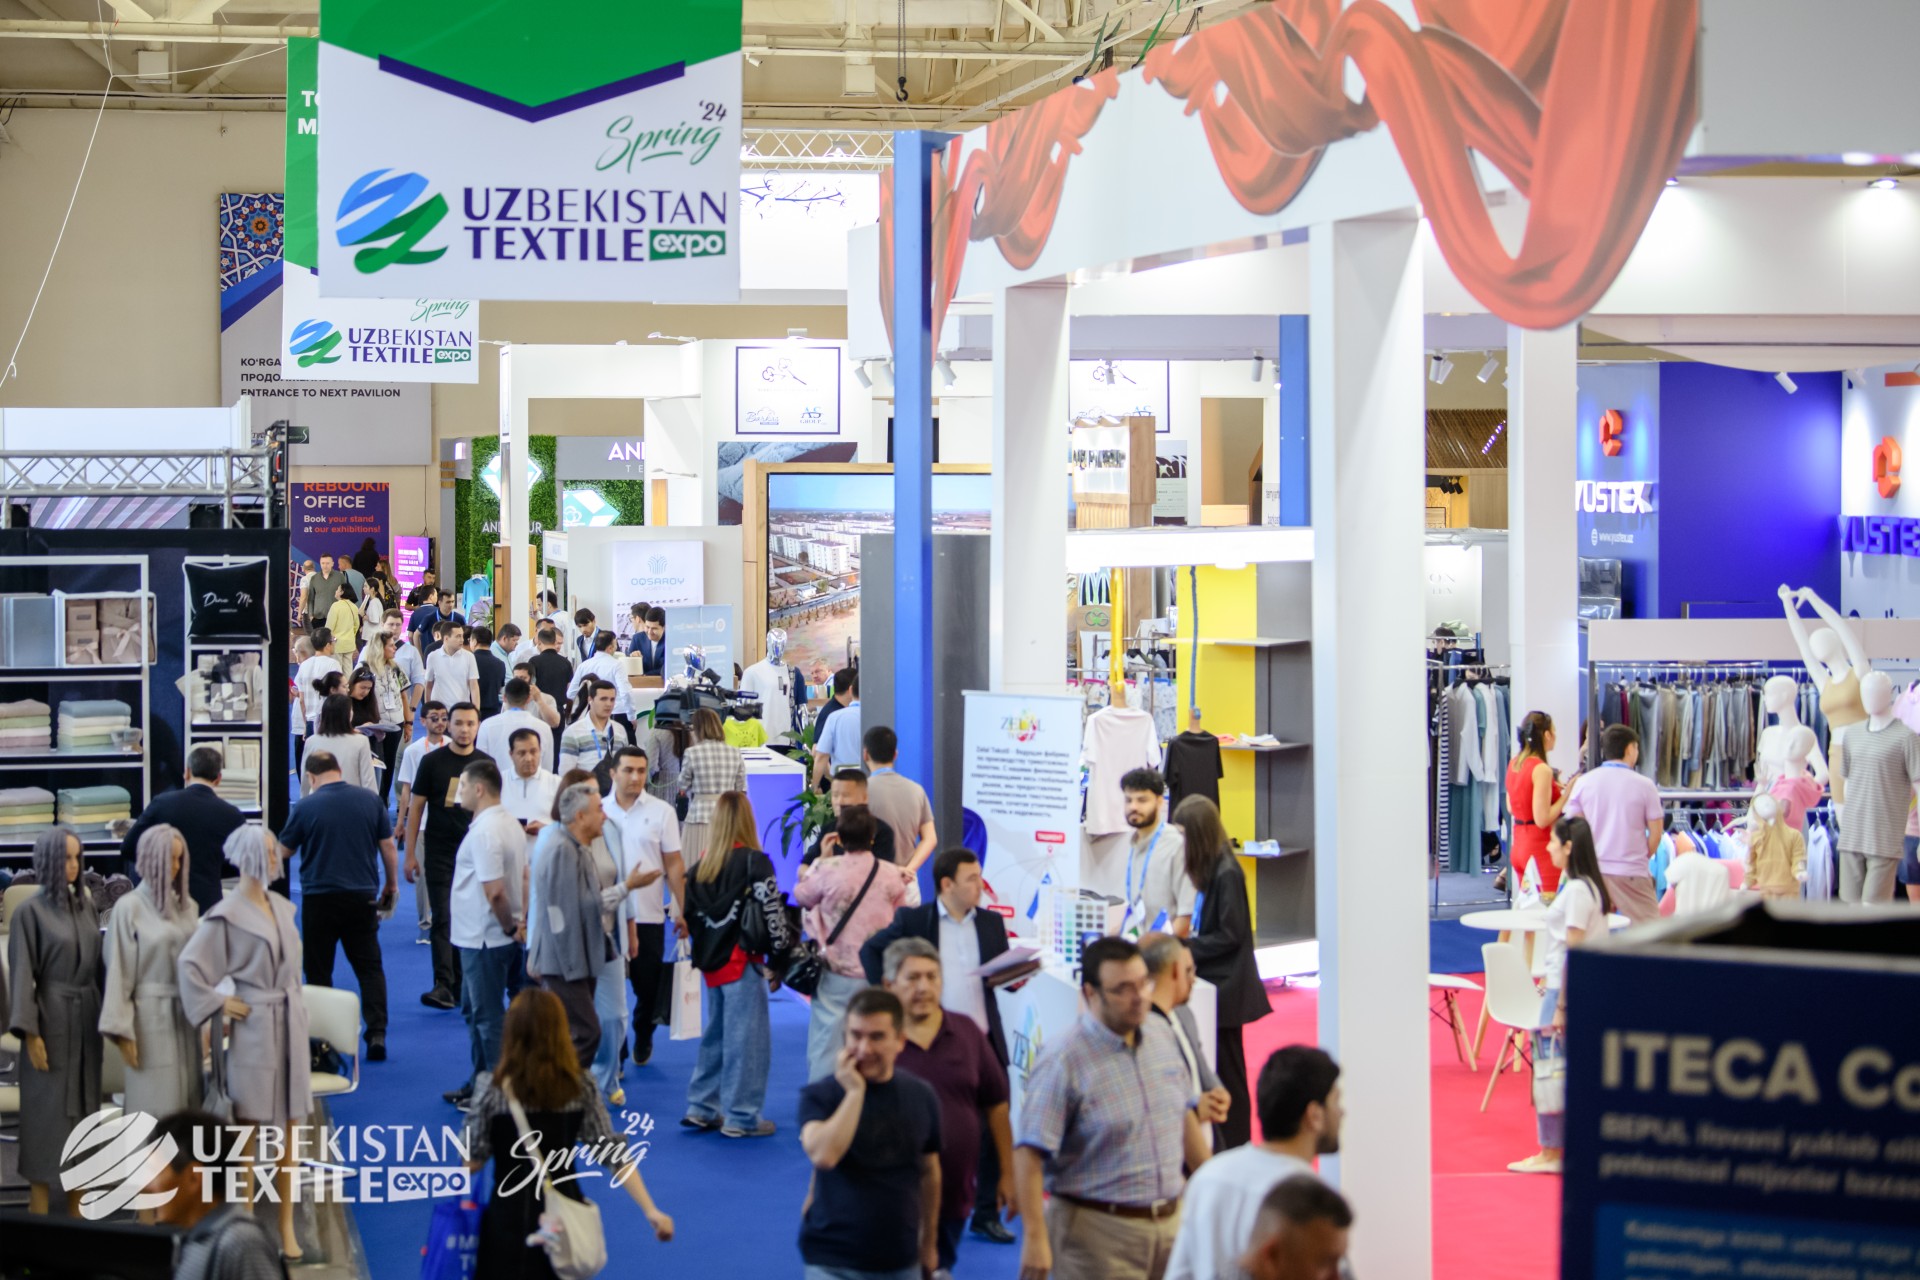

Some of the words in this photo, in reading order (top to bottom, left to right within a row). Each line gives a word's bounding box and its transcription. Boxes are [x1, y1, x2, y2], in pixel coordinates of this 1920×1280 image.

[596, 115, 722, 174] Spring
[464, 187, 726, 224] UZBEKISTAN
[464, 226, 644, 262] TEXTILE
[652, 233, 724, 258] expo
[349, 328, 471, 347] UZBEKISTAN
[349, 346, 432, 363] TEXTILE
[436, 351, 470, 362] expo
[241, 389, 299, 397] ENTRANCE
[302, 389, 317, 397] TO
[320, 389, 348, 397] NEXT
[351, 389, 400, 397] PAVILION
[304, 496, 365, 508] OFFICE
[328, 516, 347, 524] your
[631, 578, 685, 586] OQSAROY
[1601, 1029, 1820, 1105] ITECA
